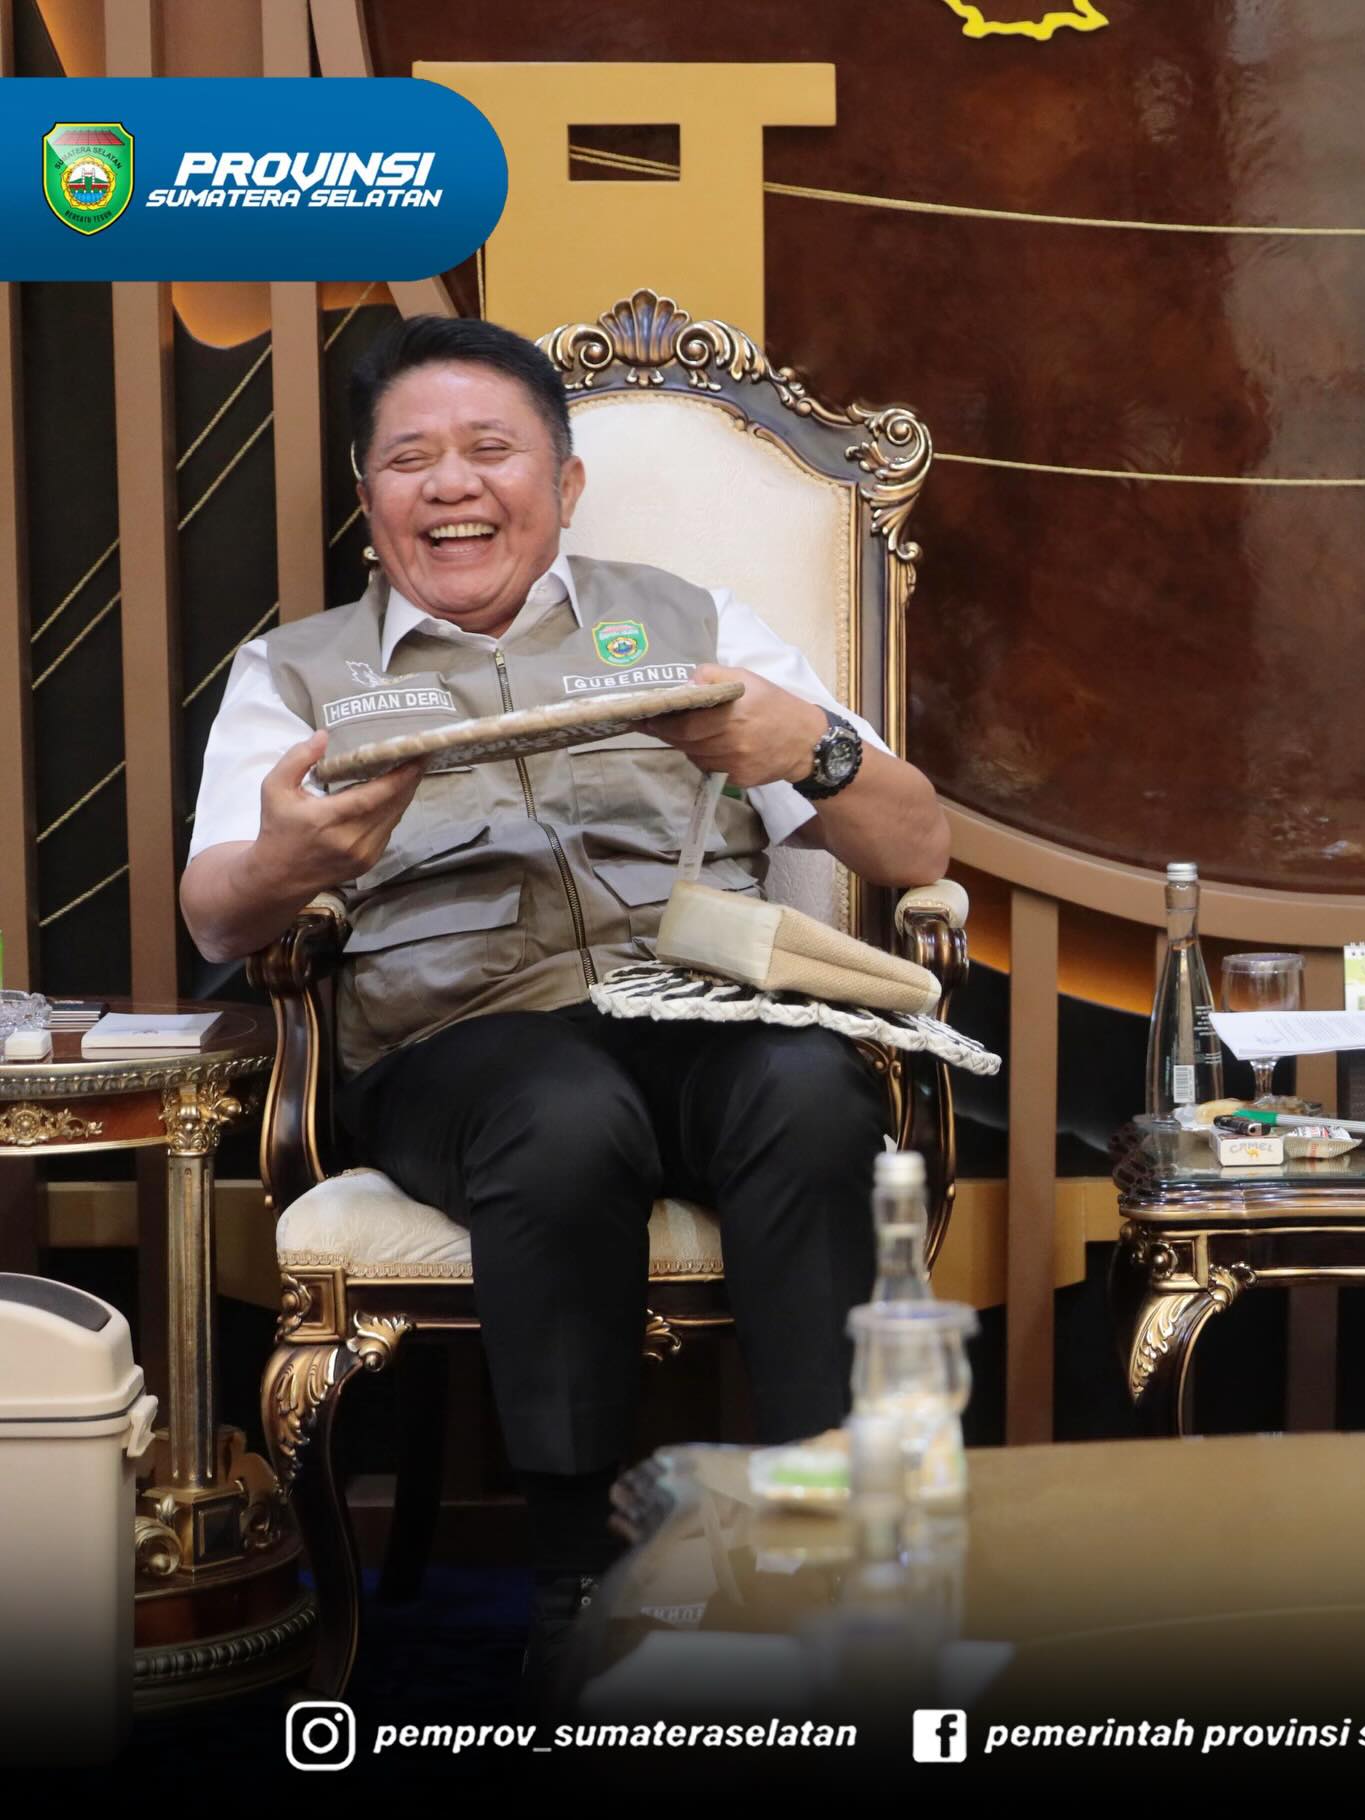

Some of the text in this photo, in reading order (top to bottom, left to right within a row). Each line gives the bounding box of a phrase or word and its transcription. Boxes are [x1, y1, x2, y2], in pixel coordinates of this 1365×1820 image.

[574, 667, 689, 689] GUBERNUR
[330, 691, 450, 721] HERMAN DERU
[1230, 1141, 1272, 1153] CAMEL
